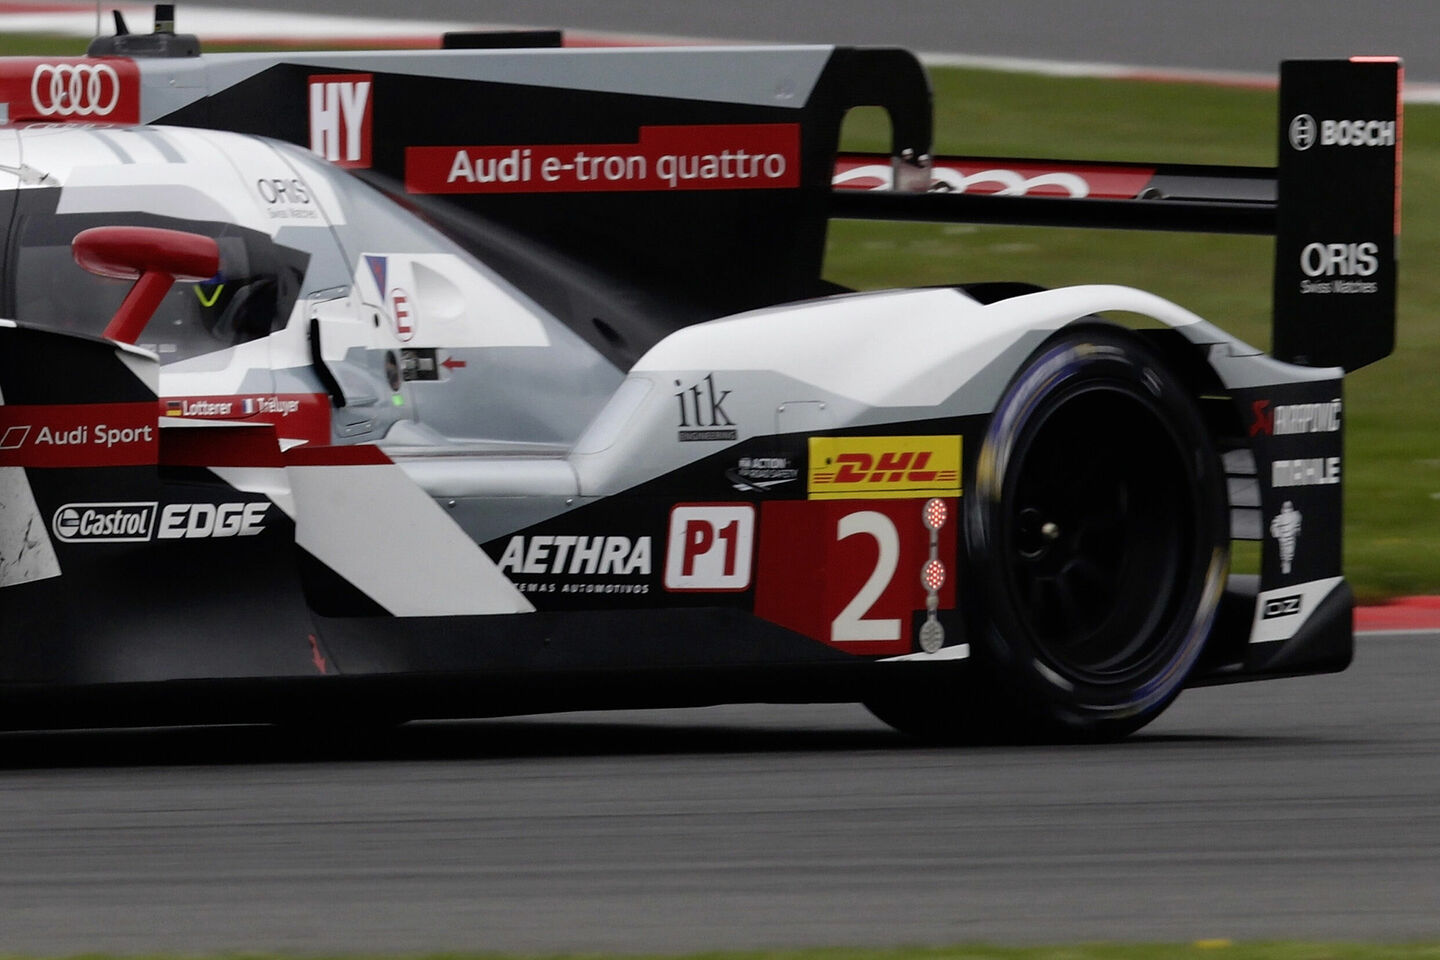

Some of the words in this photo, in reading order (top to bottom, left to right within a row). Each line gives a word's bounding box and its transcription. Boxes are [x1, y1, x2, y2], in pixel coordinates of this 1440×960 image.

[310, 81, 371, 161] HY
[1321, 119, 1395, 146] BOSCH
[447, 149, 532, 183] Audi
[541, 152, 647, 181] e-tron
[656, 149, 787, 188] quattro
[1300, 242, 1379, 277] ORIS
[674, 372, 736, 427] itk
[35, 426, 87, 445] Audi
[94, 424, 152, 448] Sport
[833, 451, 939, 483] DHL
[80, 507, 149, 535] Castrol
[157, 502, 273, 539] EDGE
[497, 535, 653, 575] AETHRA
[681, 520, 740, 577] P1
[831, 510, 902, 642] 2
